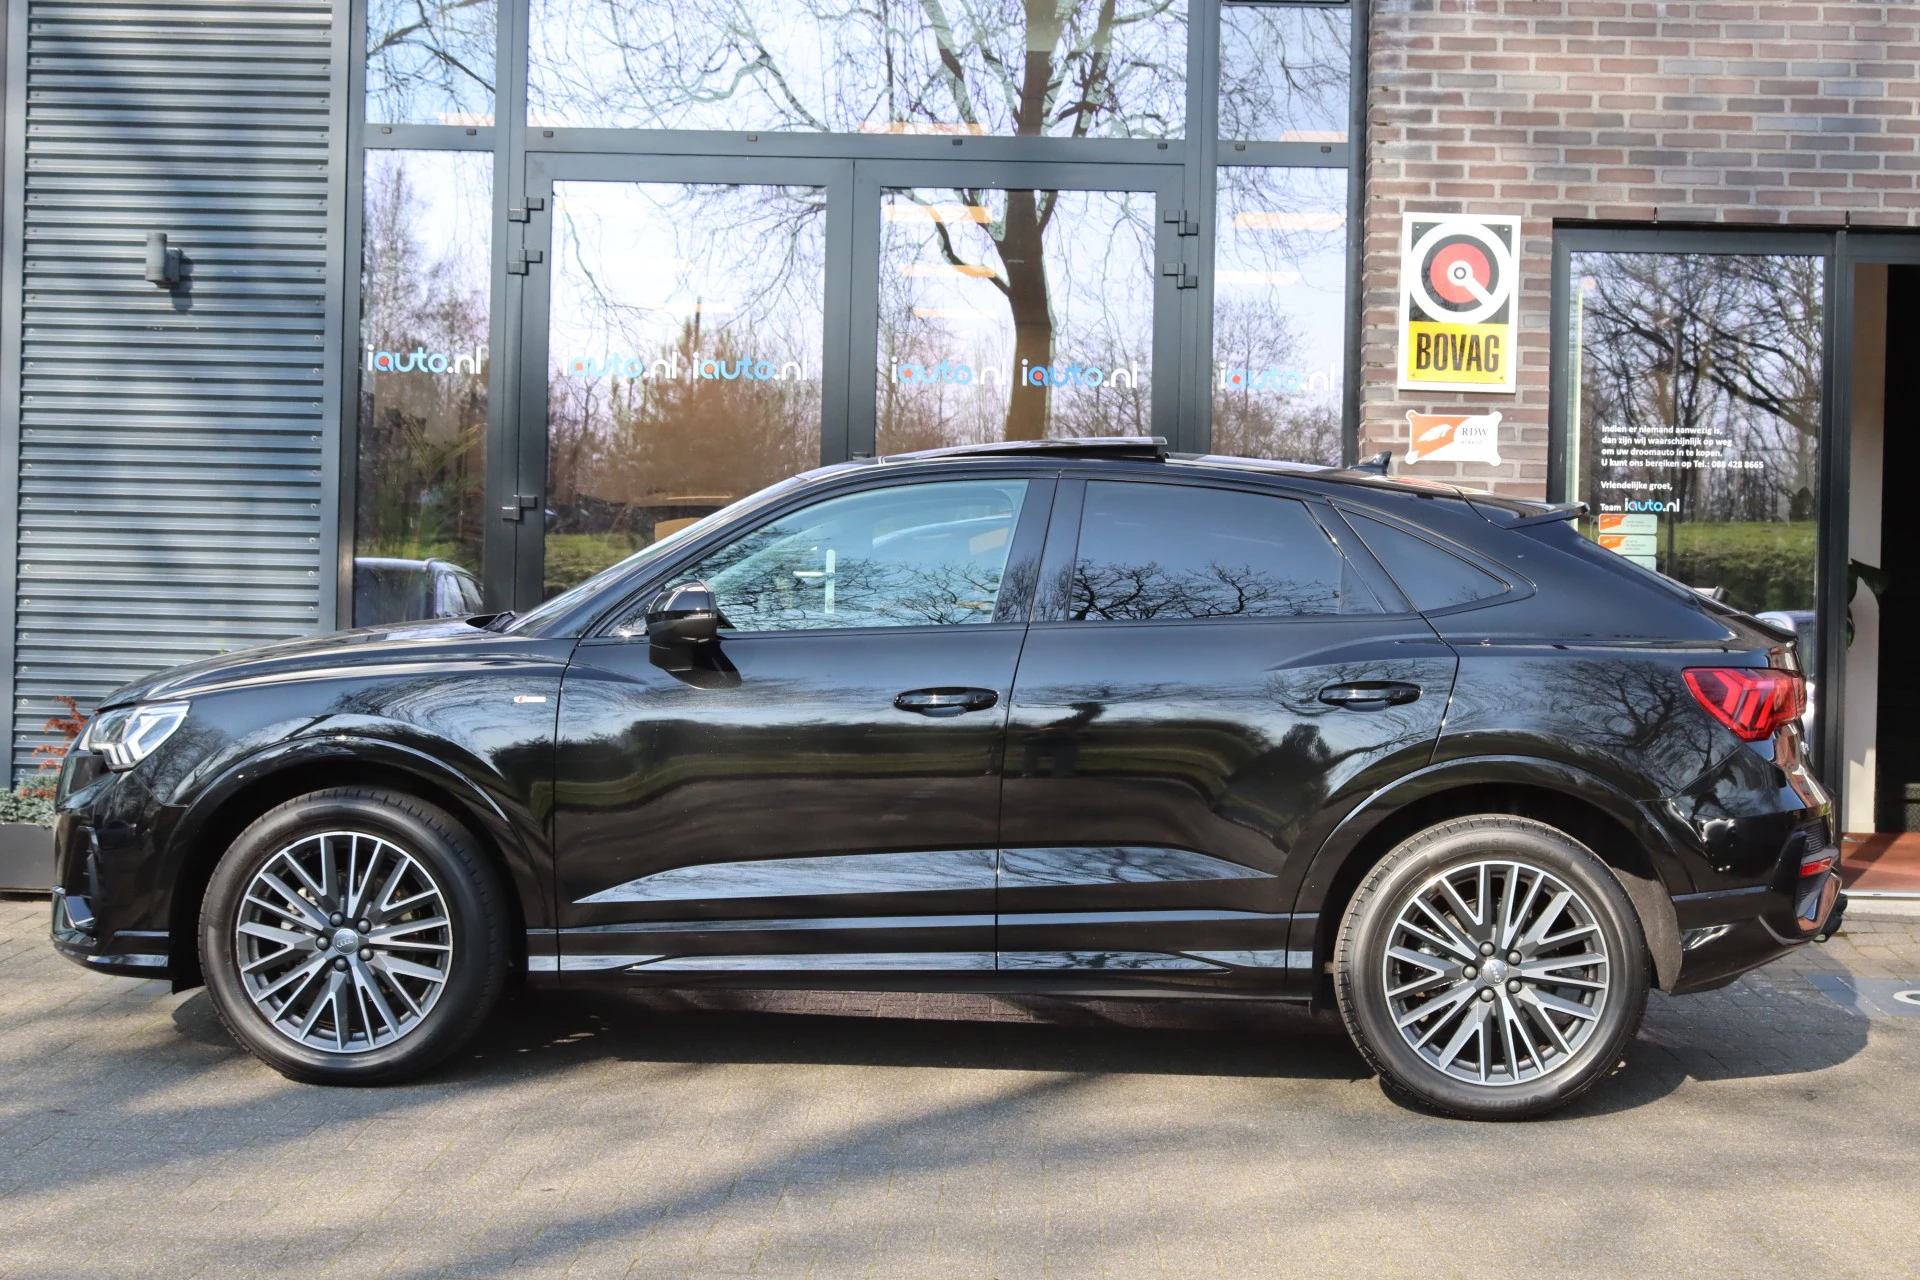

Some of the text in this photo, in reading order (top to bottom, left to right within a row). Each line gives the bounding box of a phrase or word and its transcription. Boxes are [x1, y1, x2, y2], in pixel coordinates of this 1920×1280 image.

[367, 344, 482, 375] iauto.nl
[1416, 332, 1500, 373] BOVAG
[563, 351, 678, 380] iauto.nl
[693, 352, 808, 381] iauto.nl
[891, 356, 1006, 386] iauto.nl
[1021, 358, 1138, 389] iauto.nl
[1220, 361, 1335, 391] iauto.nl
[1462, 427, 1488, 436] RDW
[1601, 425, 1627, 433] Indien
[1639, 425, 1674, 434] niemand
[1675, 427, 1712, 435] aanwezig
[1713, 427, 1723, 435] is,
[1601, 436, 1617, 444] dan
[1618, 437, 1632, 446] zijn
[1634, 437, 1647, 446] wij
[1648, 437, 1701, 446] waarschijnlijk
[1715, 440, 1732, 448] weg
[1601, 448, 1615, 456] om
[1616, 448, 1629, 456] uw
[1630, 448, 1675, 456] droomauto
[1676, 448, 1684, 456] in
[1695, 448, 1723, 457] kopen.
[1601, 458, 1608, 467] U
[1609, 458, 1628, 467] kunt
[1645, 459, 1680, 468] bereiken
[1681, 461, 1692, 469] op
[1693, 460, 1710, 468] Tel.:
[1744, 461, 1764, 469] 8665
[1600, 481, 1673, 491] Vriendelijke groet,
[1600, 497, 1680, 512] Team iauto.nl
